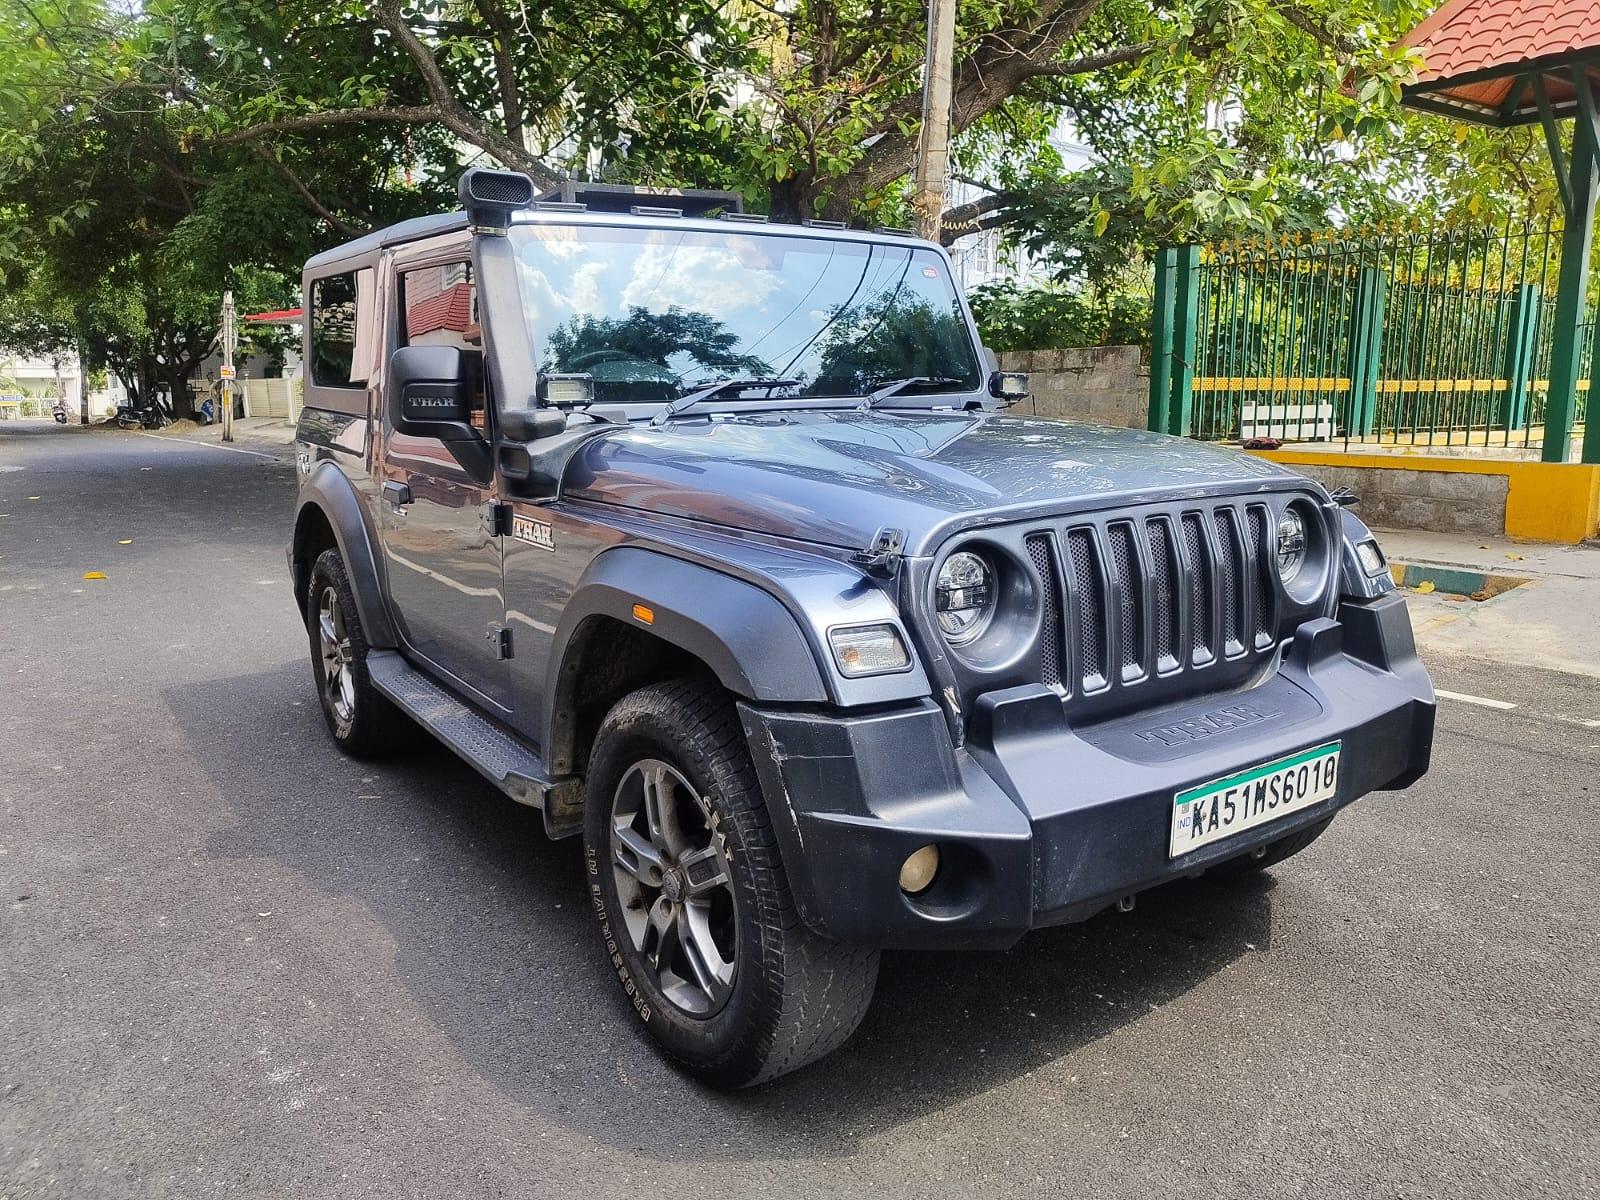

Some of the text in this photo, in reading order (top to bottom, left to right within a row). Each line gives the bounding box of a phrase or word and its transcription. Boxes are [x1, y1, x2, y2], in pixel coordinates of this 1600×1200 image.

[408, 397, 456, 407] THAR
[514, 520, 555, 547] THAR
[1134, 704, 1282, 747] THAR
[1191, 756, 1336, 839] KA51MS6010
[1177, 816, 1191, 830] IND
